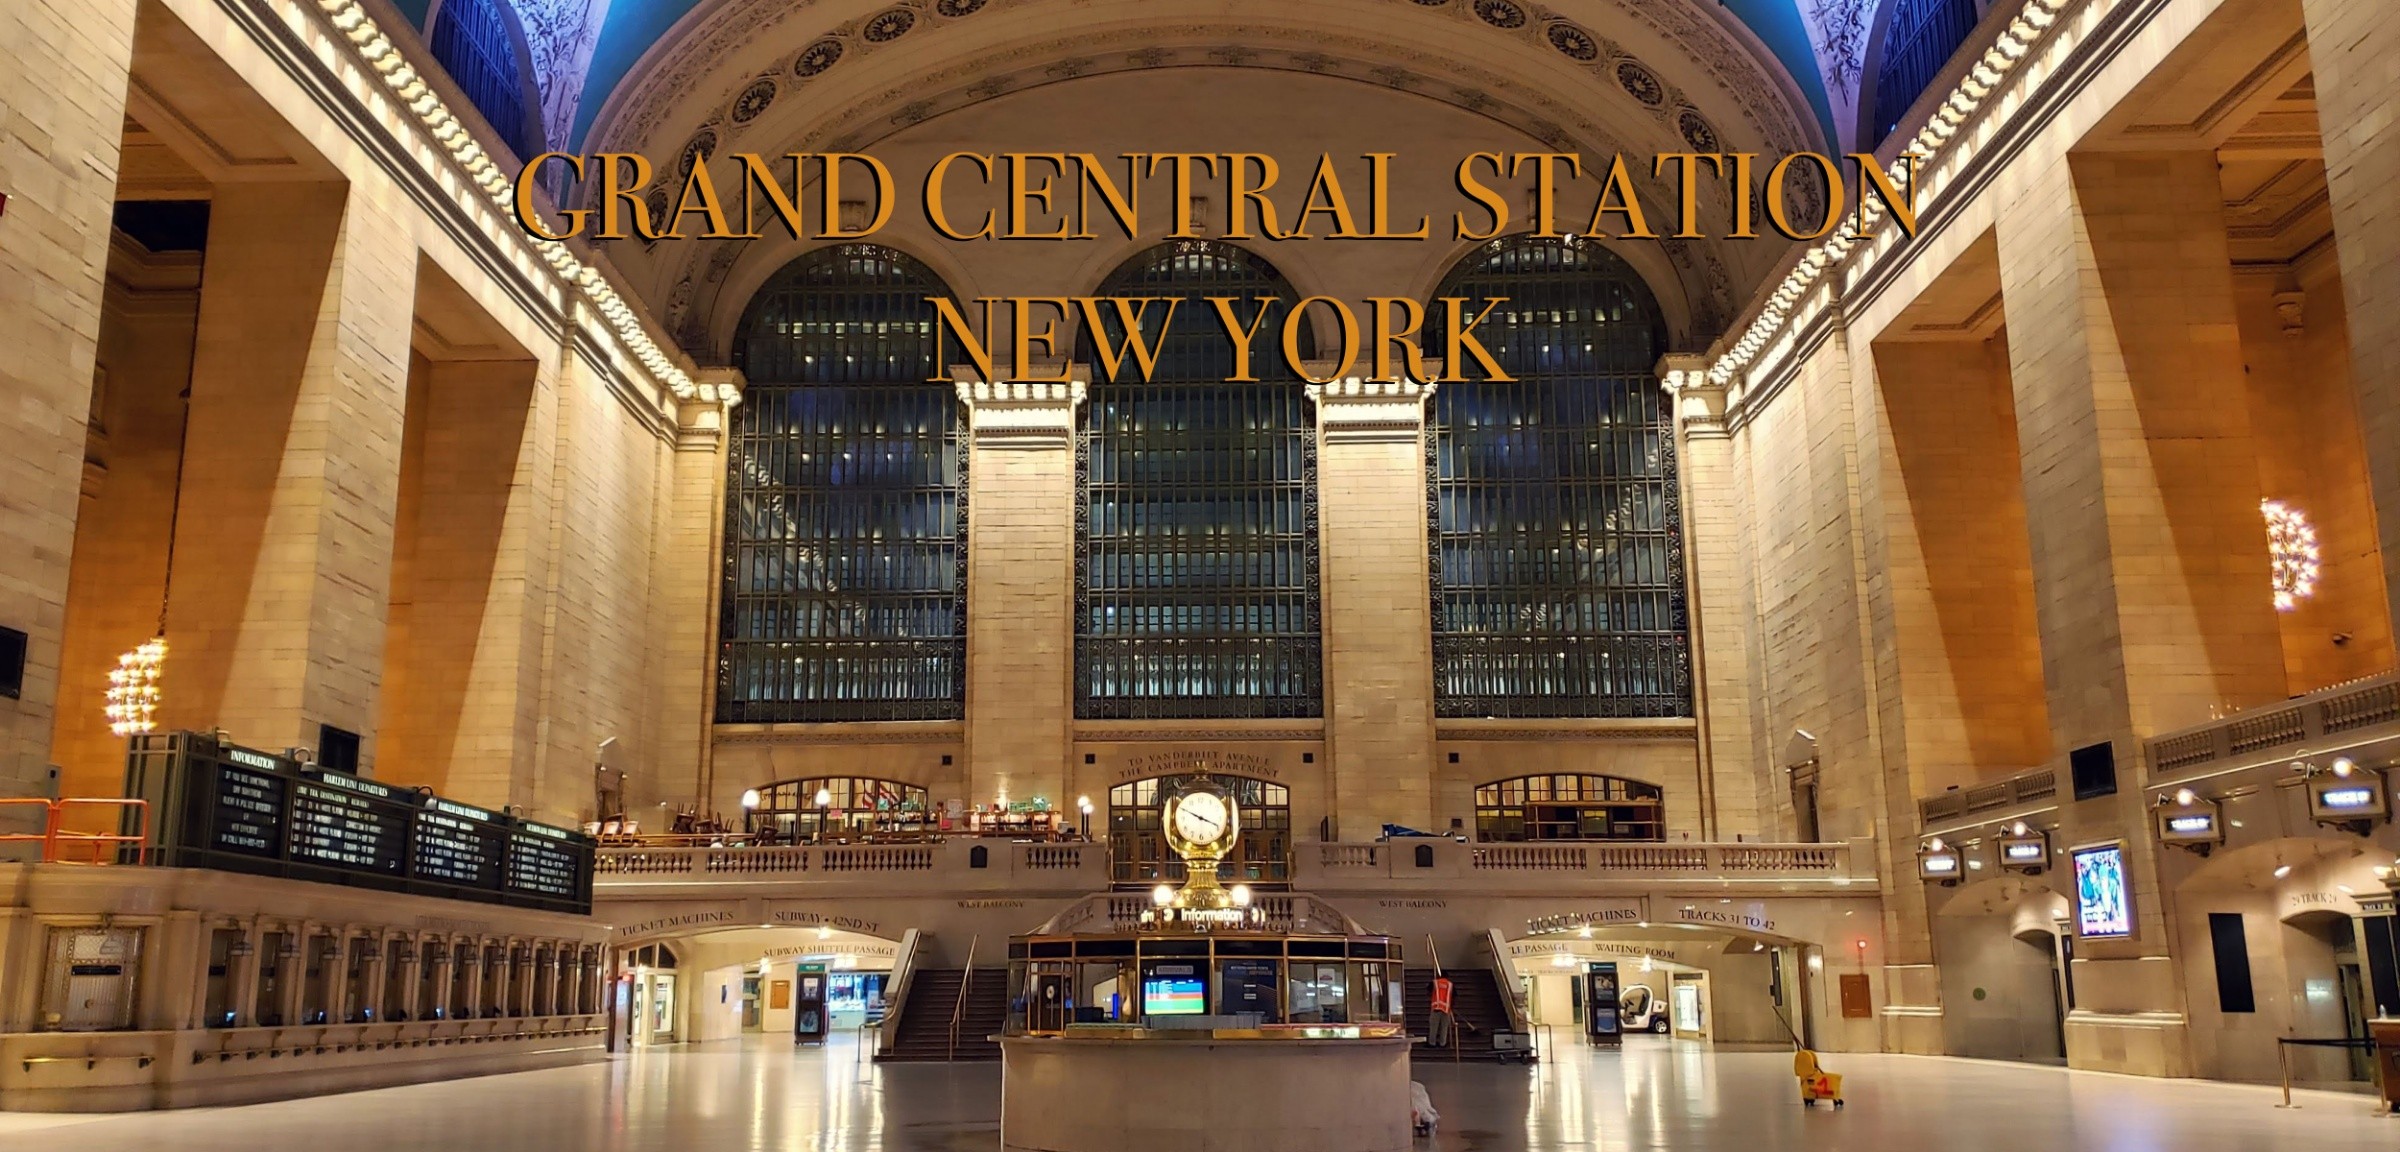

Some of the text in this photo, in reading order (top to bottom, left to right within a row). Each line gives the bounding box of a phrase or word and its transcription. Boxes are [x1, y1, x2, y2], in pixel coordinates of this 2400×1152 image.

[231, 750, 275, 770] INFORMATION
[1128, 751, 1270, 767] TO VANDERBILT AVENUE
[1119, 760, 1279, 779] THE CAMPBEL APARTMENT
[323, 773, 346, 787] HARLEM
[1379, 900, 1447, 908] WEST BALCONY
[2301, 892, 2327, 904] TRACK
[775, 911, 879, 933] SUBWAY 42ND ST
[1181, 907, 1243, 922] Information
[1529, 909, 1637, 931] TICKET MACHINES
[1679, 909, 1775, 931] TRACKS 31 TO 42
[620, 911, 734, 937] TICKET MACHINES
[764, 944, 895, 957] SUBWAY SHUTTLE PASSAGE
[1525, 943, 1568, 953] PASSAGE
[1595, 943, 1675, 960] WAITING ROOM
